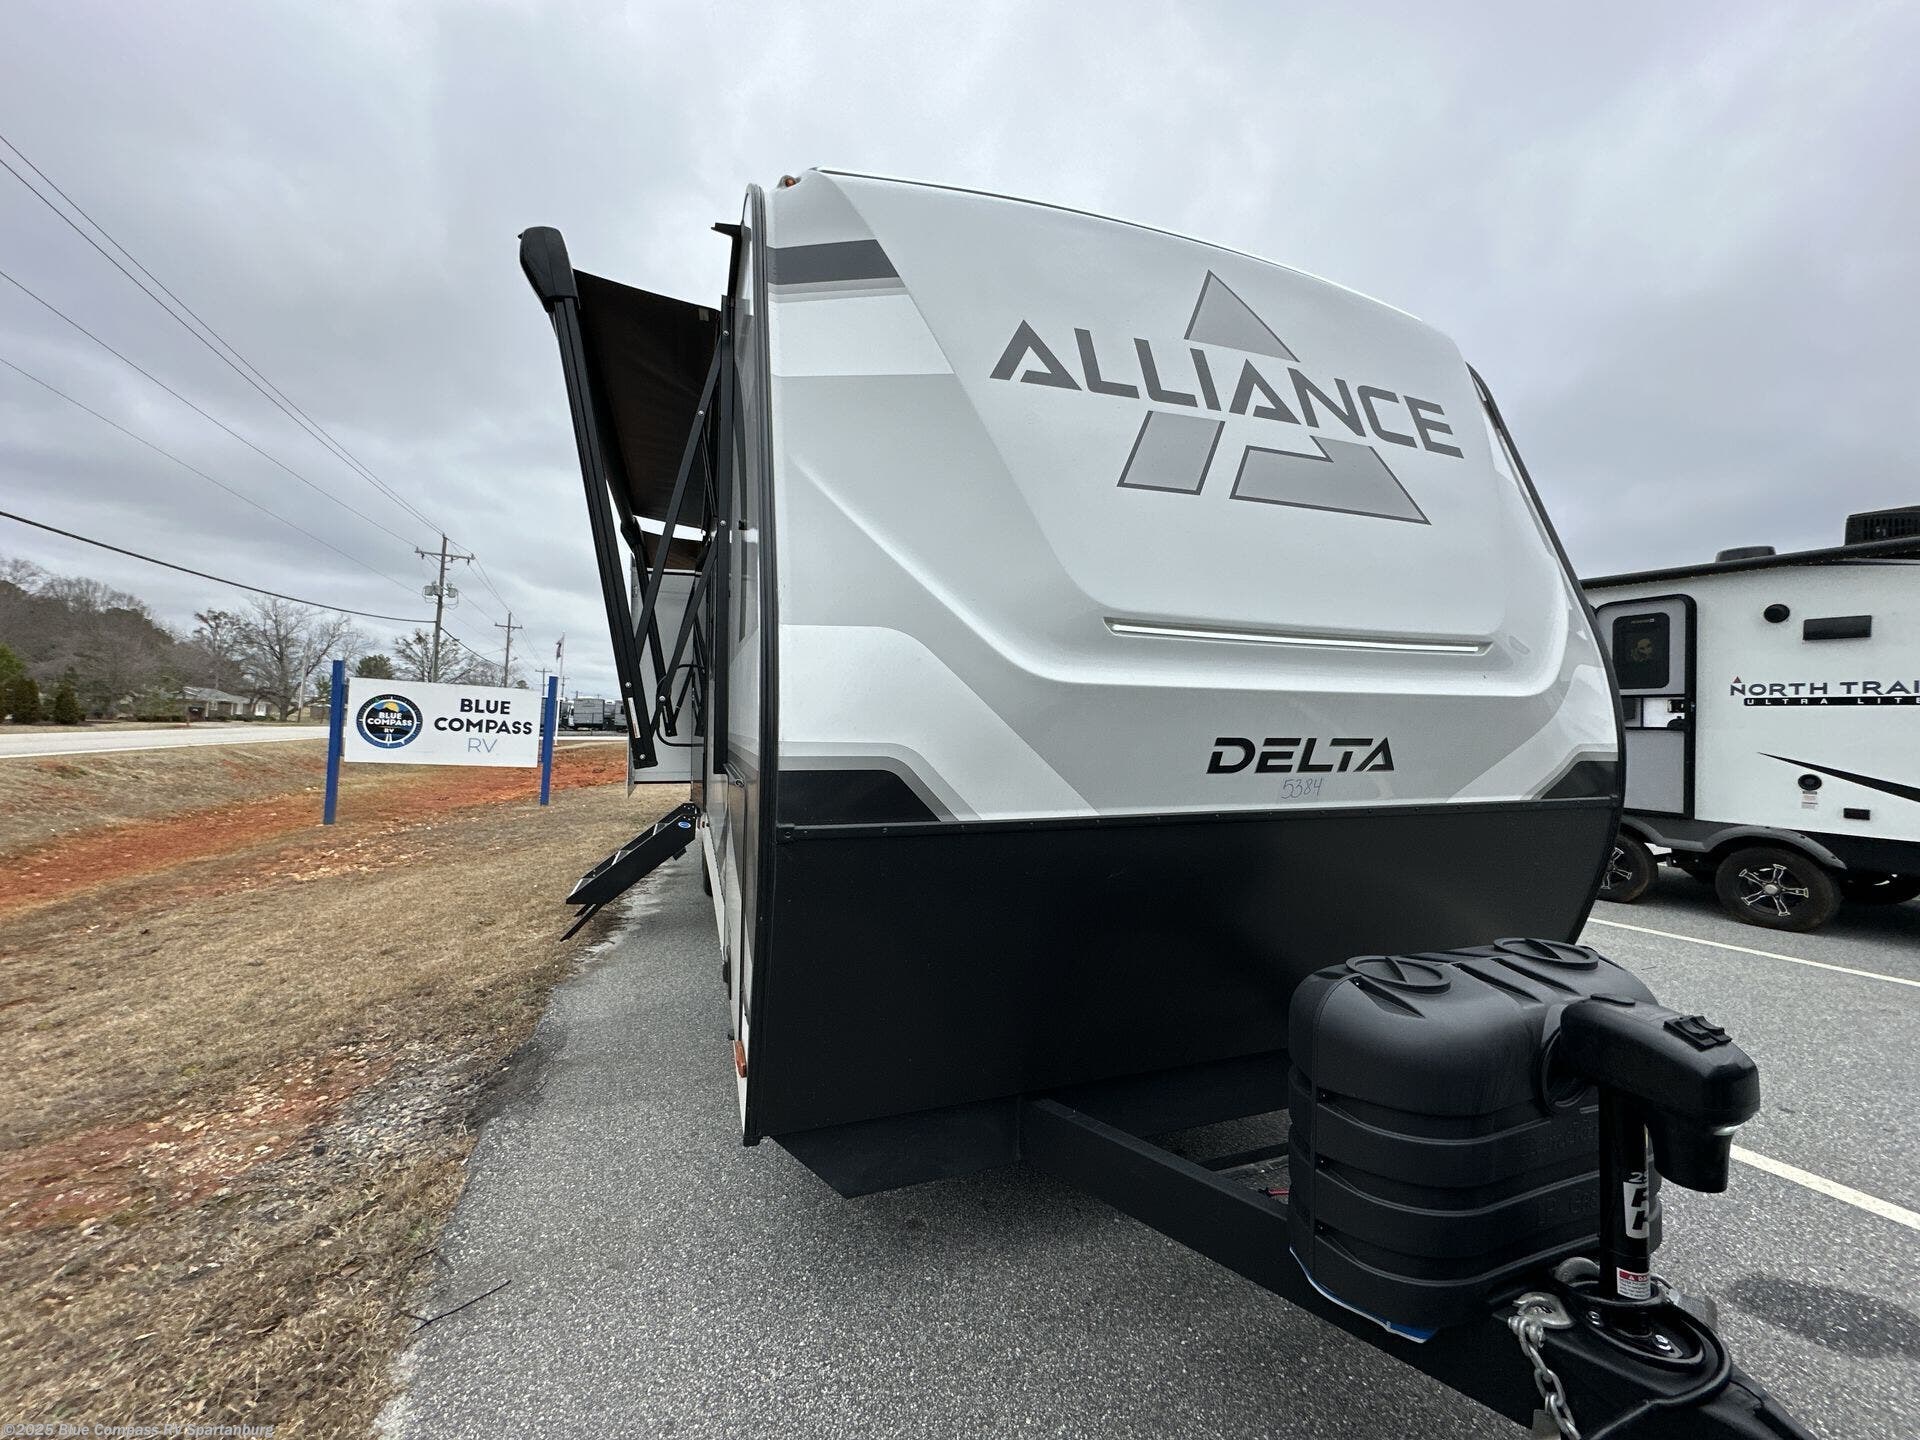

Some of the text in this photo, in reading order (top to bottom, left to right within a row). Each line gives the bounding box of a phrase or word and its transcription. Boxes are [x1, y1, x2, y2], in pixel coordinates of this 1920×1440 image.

[990, 319, 1464, 459] ALLIANCE
[1730, 682, 1828, 696] NORTH
[460, 698, 511, 715] BLUE
[1746, 697, 1829, 705] ULTRA
[367, 718, 413, 727] COMPASS
[379, 711, 403, 719] BLUE
[434, 717, 532, 735] COMPASS
[468, 737, 498, 752] RV
[1206, 737, 1395, 774] DELTA
[1281, 777, 1323, 799] 5384
